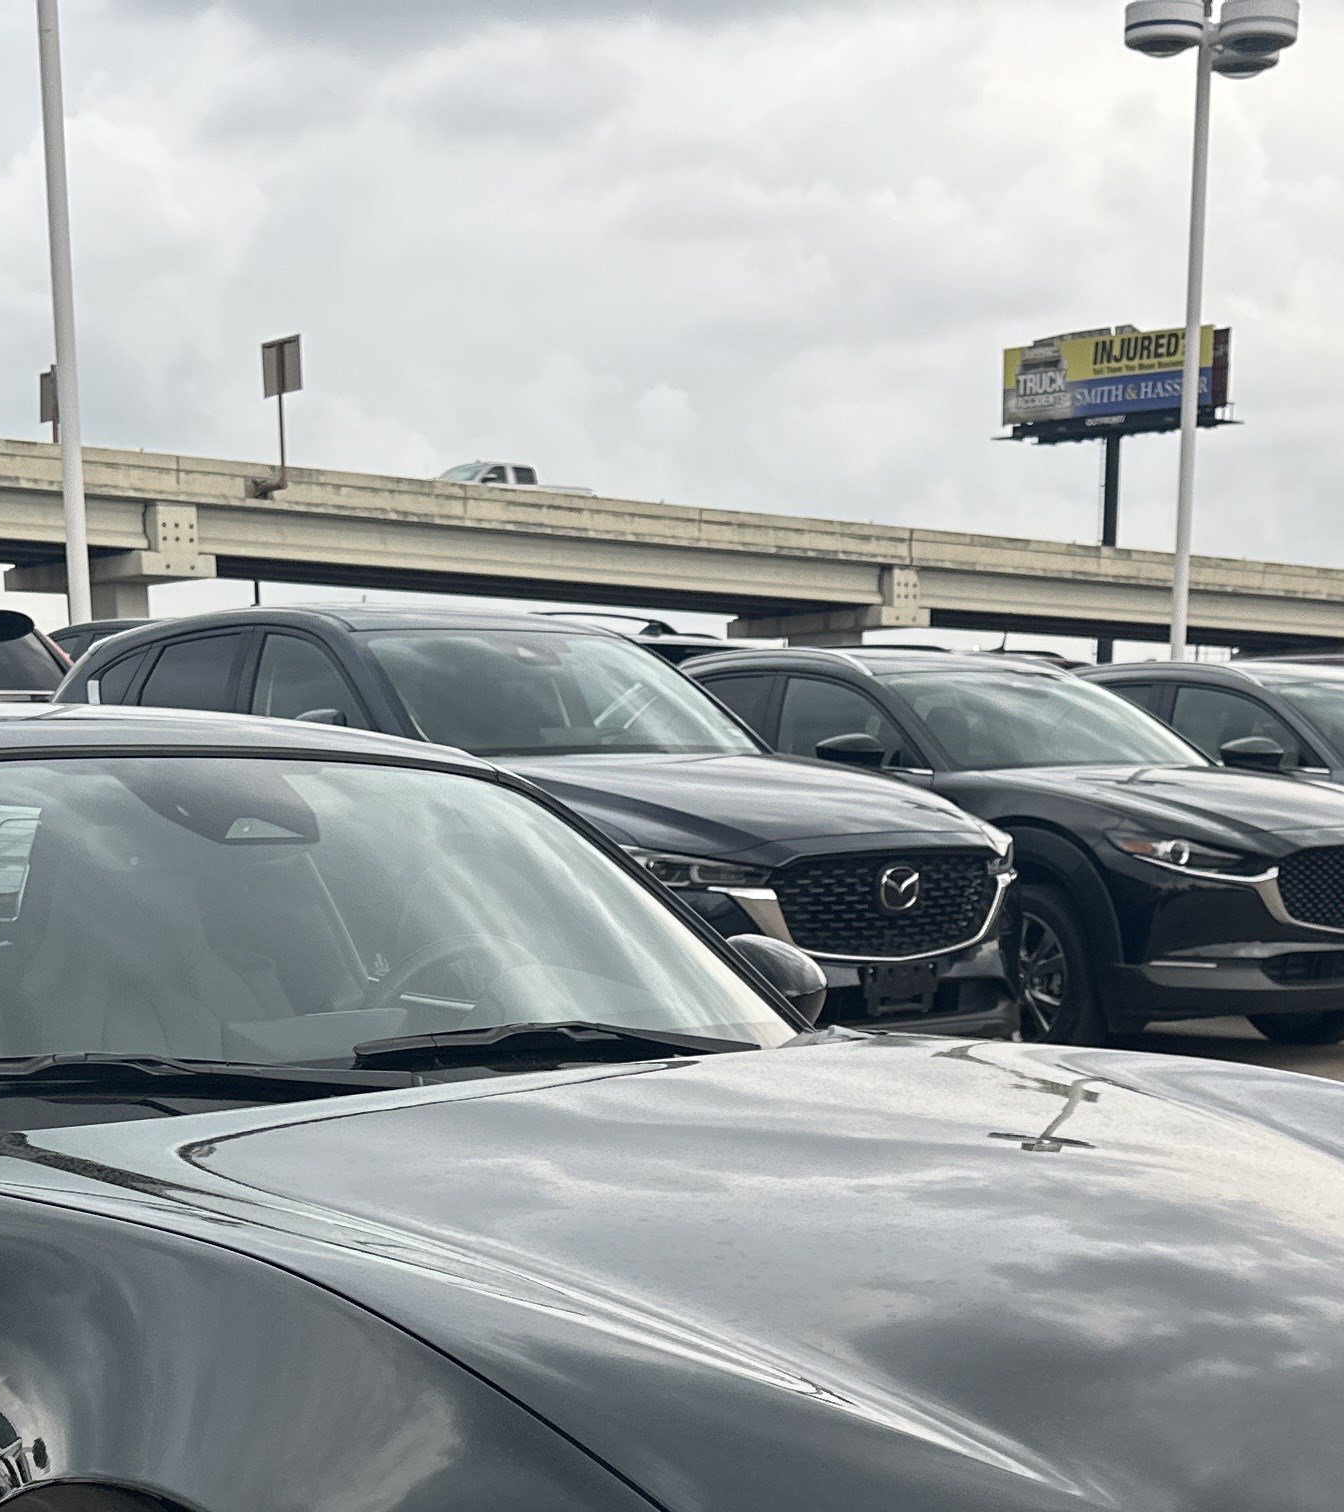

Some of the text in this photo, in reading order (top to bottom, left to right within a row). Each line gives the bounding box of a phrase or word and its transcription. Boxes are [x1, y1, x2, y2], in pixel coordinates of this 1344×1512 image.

[1017, 371, 1065, 397] TRUCK
[1074, 376, 1208, 406] SMITH & HASSR
